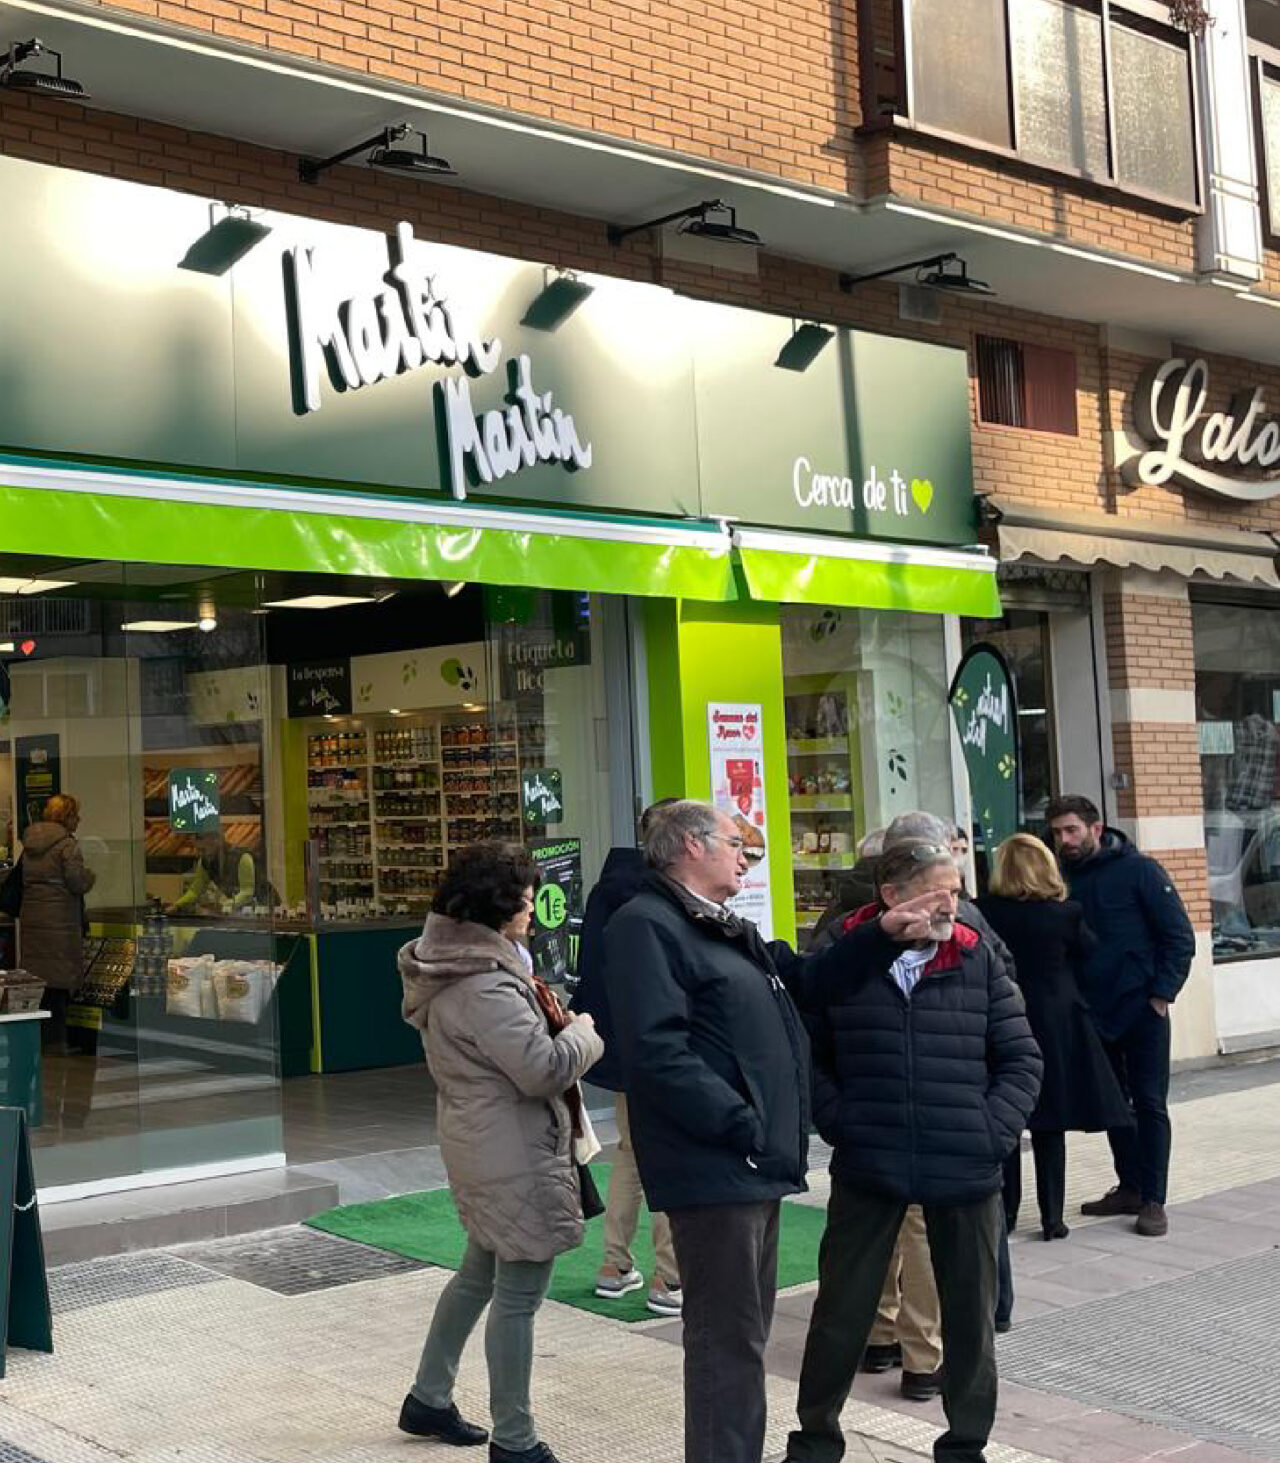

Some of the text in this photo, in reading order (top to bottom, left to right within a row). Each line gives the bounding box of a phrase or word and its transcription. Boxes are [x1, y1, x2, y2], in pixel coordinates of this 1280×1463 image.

[793, 457, 908, 516] Cerca de ti
